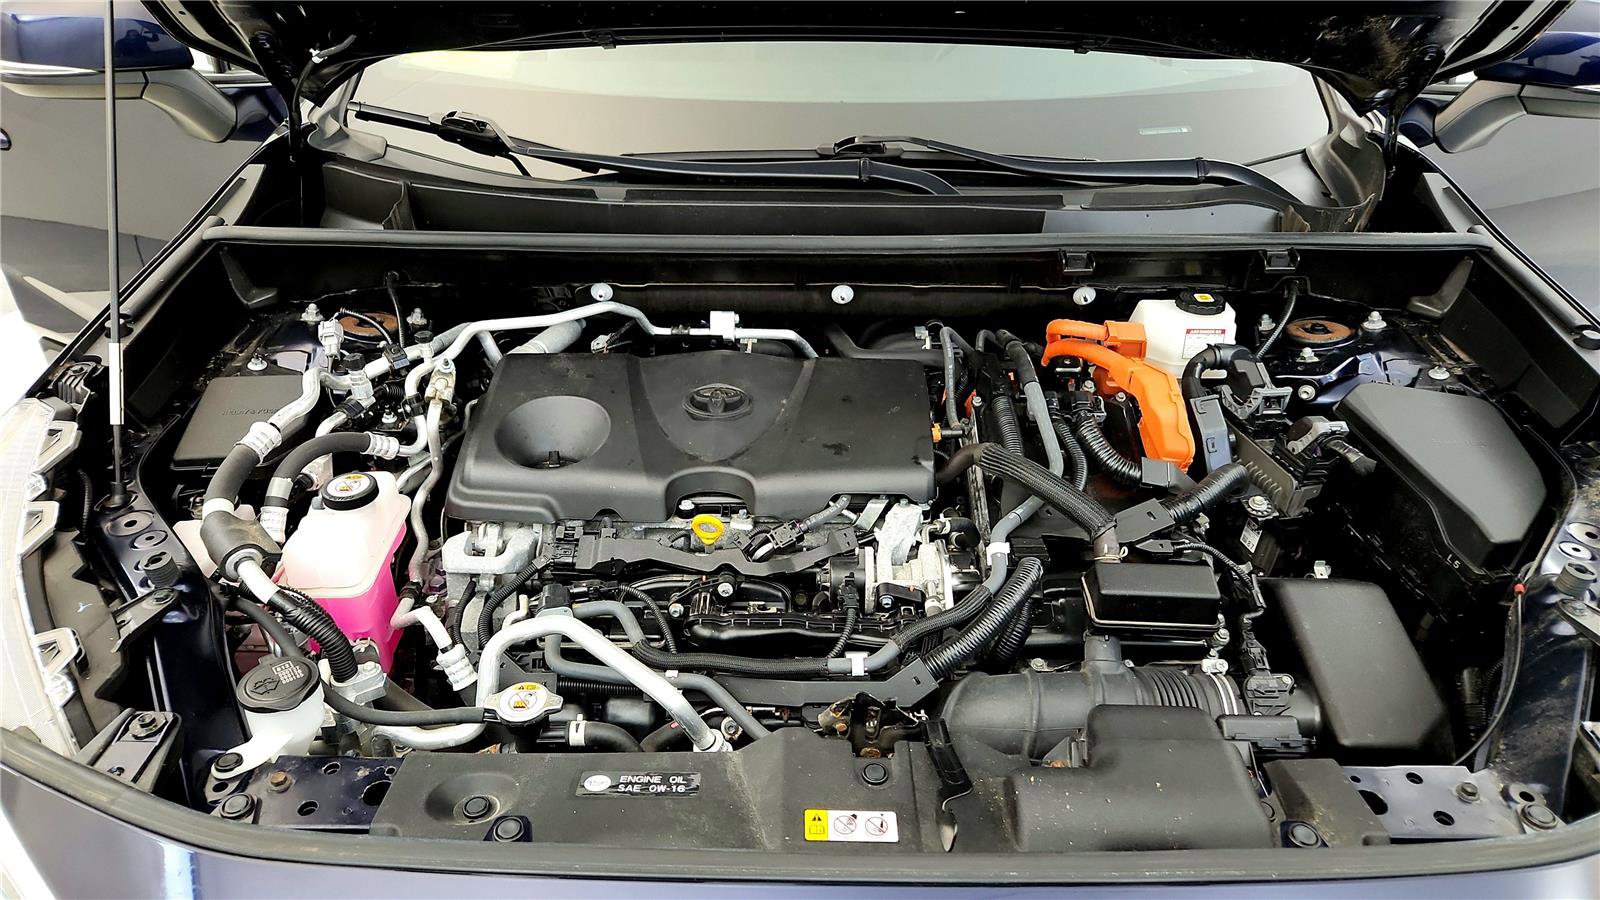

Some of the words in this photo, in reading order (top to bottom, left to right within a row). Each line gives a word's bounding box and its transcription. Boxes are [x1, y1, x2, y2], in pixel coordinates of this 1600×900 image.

[619, 775, 662, 783] ENGINE
[669, 775, 687, 783] OIL
[617, 784, 641, 792] SAE
[648, 784, 686, 793] 0W-16
